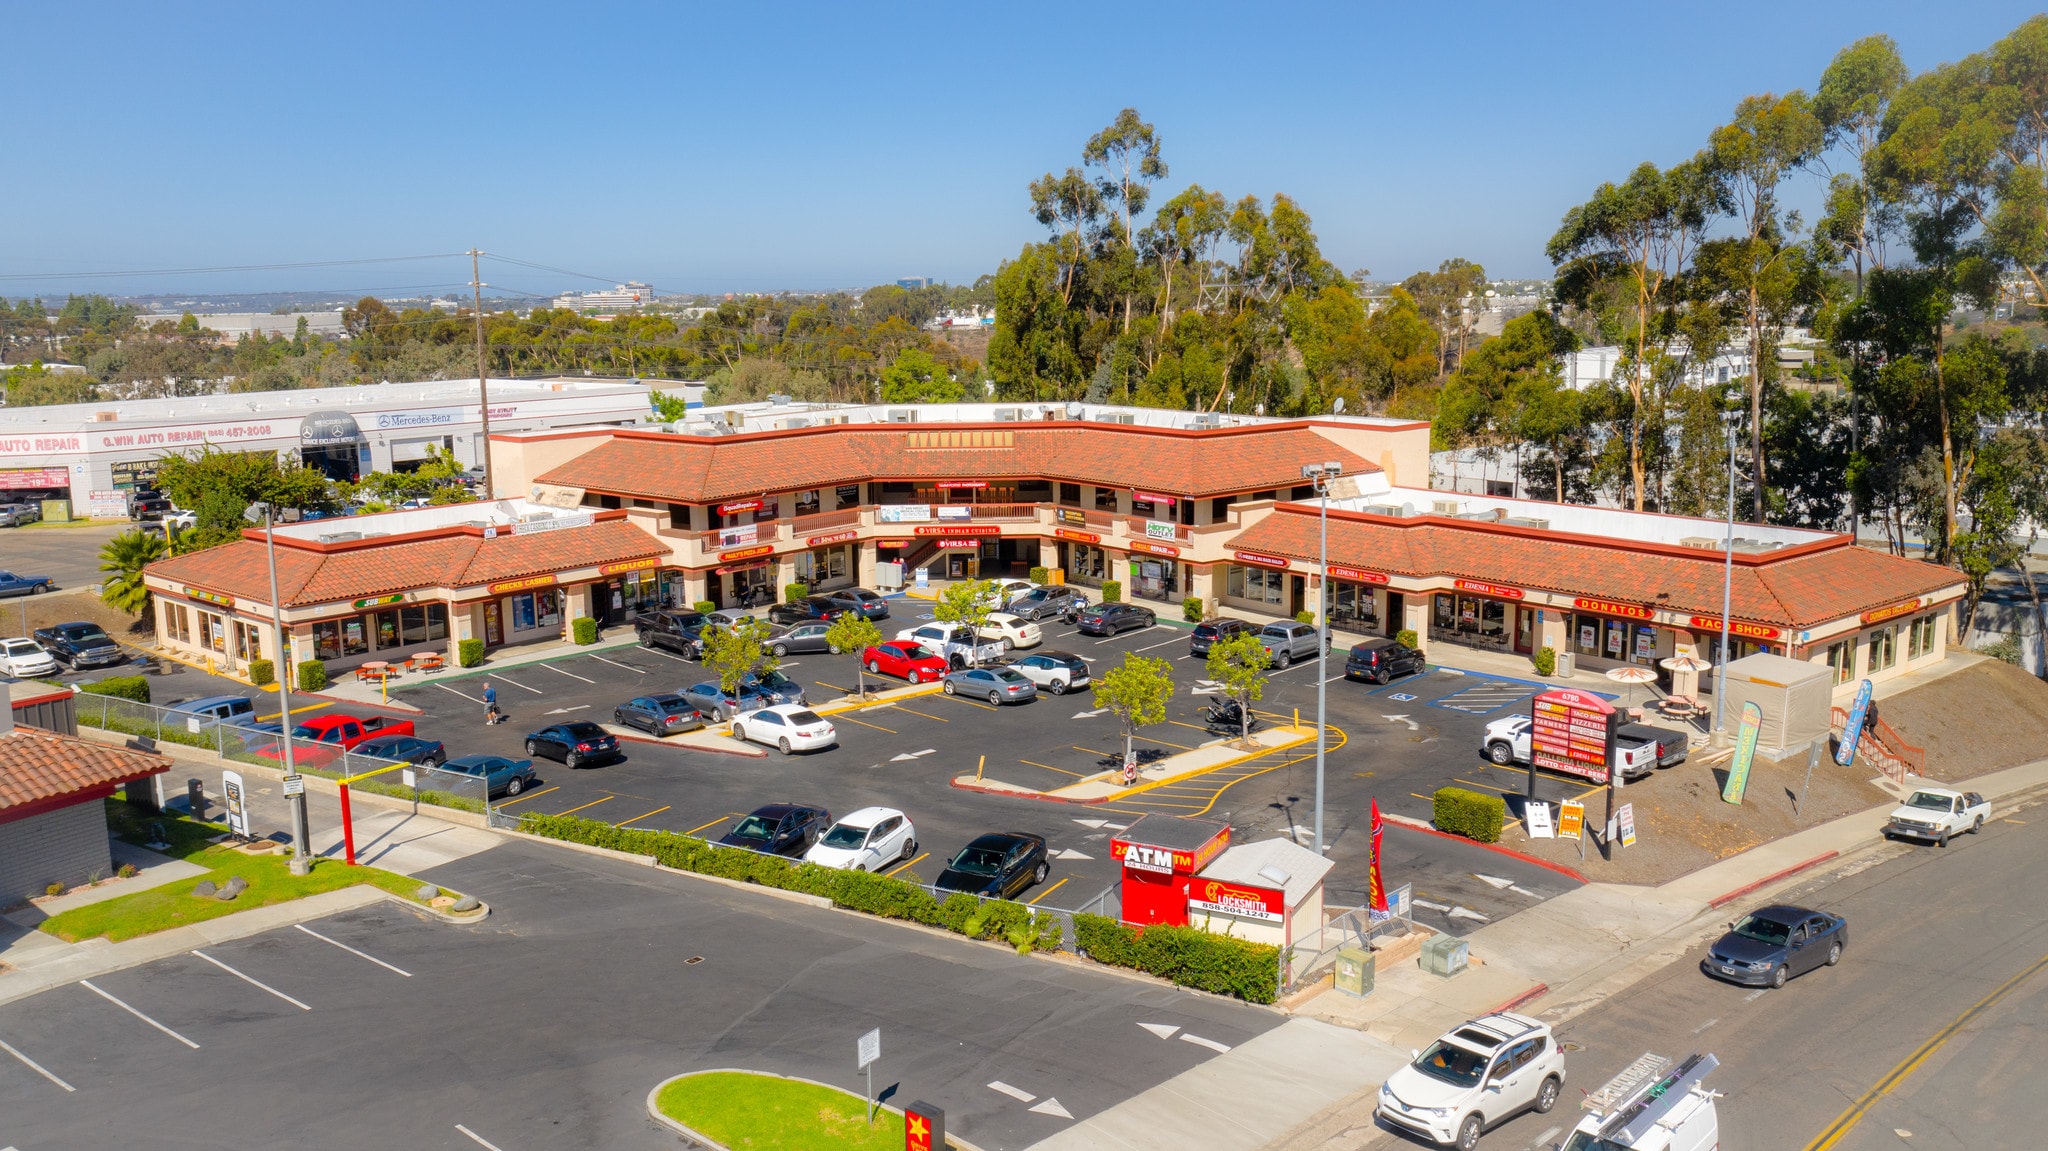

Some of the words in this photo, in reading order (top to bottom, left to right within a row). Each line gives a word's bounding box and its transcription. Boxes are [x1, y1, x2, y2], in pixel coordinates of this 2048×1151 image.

[391, 414, 452, 426] Mercedes-Benz
[138, 433, 165, 445] AUTO
[168, 431, 203, 442] REPAIR
[226, 425, 272, 438] 457-2008
[0, 439, 30, 452] AUTO
[35, 437, 80, 450] REPAIR
[1147, 523, 1174, 532] HDTV
[1147, 529, 1173, 538] OUTLET
[608, 559, 654, 572] LIQUOR
[628, 572, 638, 580] EBT
[1336, 568, 1358, 578] EDESIA
[494, 580, 523, 592] CHECKS
[525, 576, 553, 586] CASHED
[1464, 582, 1489, 592] EDESIA
[364, 595, 395, 606] SUBWAY
[1581, 600, 1646, 617] DONATOS
[1870, 608, 1892, 620] DONATOS
[1736, 624, 1770, 636] SHOP
[1562, 692, 1580, 702] 6780
[1535, 701, 1570, 713] SUBWAY
[1572, 710, 1588, 718] TACO
[1536, 718, 1567, 730] FARMERS
[1572, 718, 1606, 732] PIZZERIA
[1536, 752, 1575, 764] GALLERIA
[1576, 760, 1608, 773] LIQUOR
[1536, 758, 1559, 768] LOTTO
[1563, 764, 1588, 774] CRAFT
[1587, 770, 1607, 780] BEER
[1204, 841, 1217, 859] HOUR
[1218, 831, 1229, 848] ATM
[1125, 845, 1172, 868] ATM
[1172, 854, 1190, 866] TM
[1139, 863, 1170, 873] HOURS
[1218, 894, 1266, 912] LOCKSMITH
[1202, 902, 1270, 918] 858-504-1247
